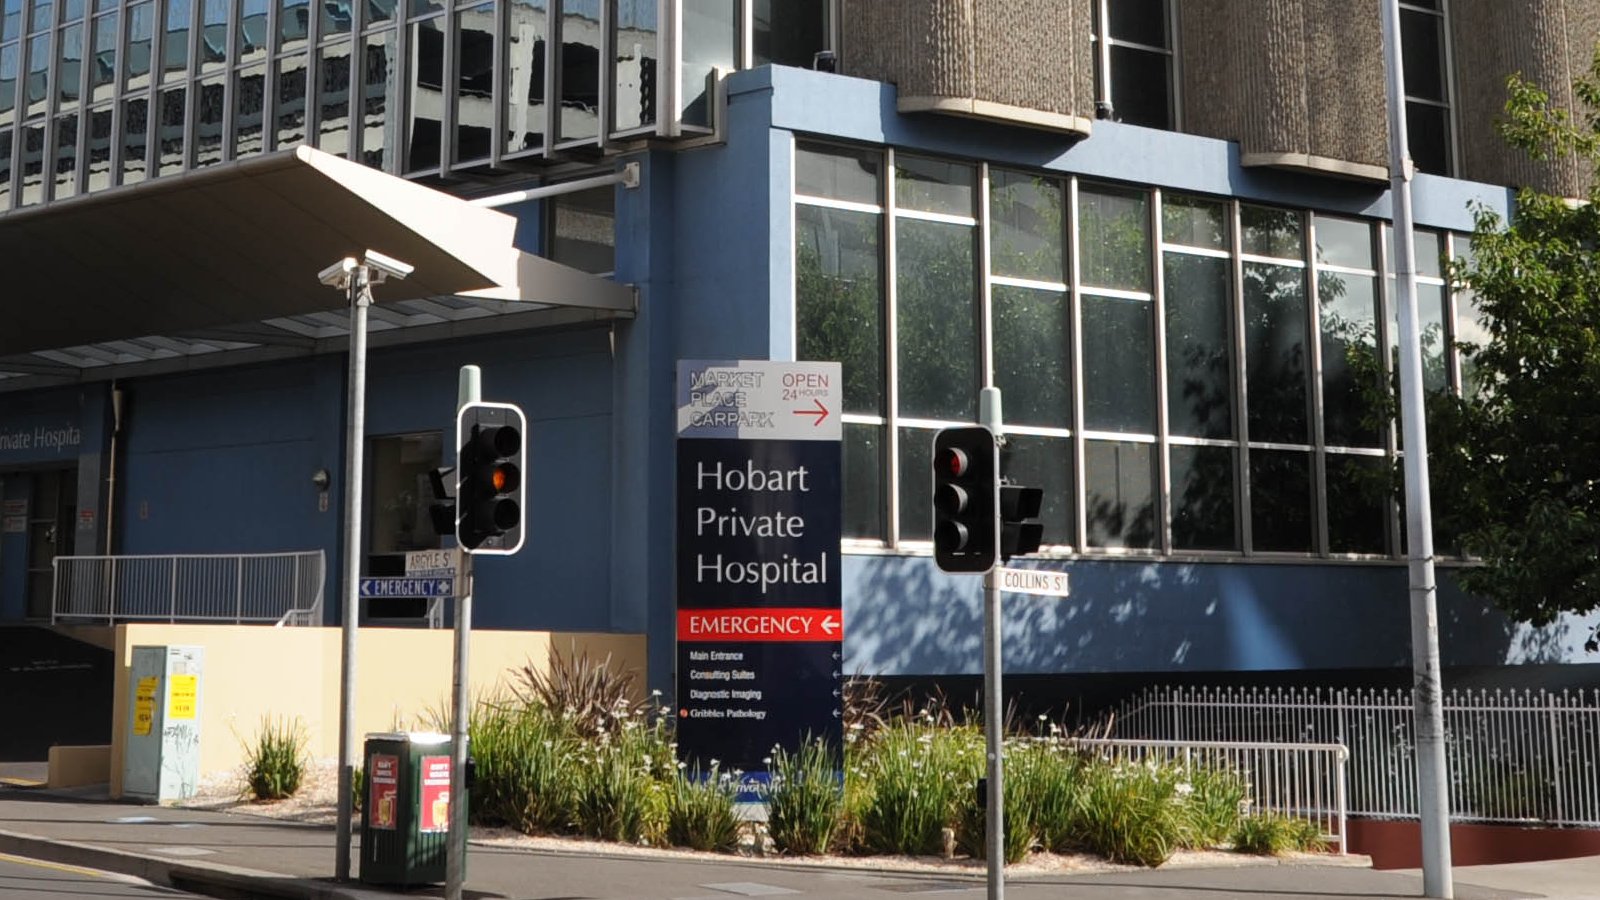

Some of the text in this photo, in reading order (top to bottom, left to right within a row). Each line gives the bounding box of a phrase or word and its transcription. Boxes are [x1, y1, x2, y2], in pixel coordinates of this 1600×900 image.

[690, 371, 765, 389] MARKET
[782, 373, 829, 388] OPEN
[690, 391, 747, 408] PLACE
[782, 387, 829, 401] 24 HOURS
[690, 410, 776, 428] CARPARK
[0, 422, 80, 453] rivate Hospita
[697, 459, 810, 491] Hobart
[697, 507, 805, 537] Private
[411, 554, 440, 569] ARGYLE
[697, 551, 827, 594] Hospital
[375, 580, 436, 596] EMERGENCY
[1005, 573, 1049, 591] COLLINS
[690, 616, 813, 635] EMERGENCY
[690, 652, 743, 661] Main Entrance
[690, 670, 755, 681] Consulting Suites
[690, 689, 762, 700] Diagnostic Imaging
[690, 708, 767, 720] Gribbles Pathology
